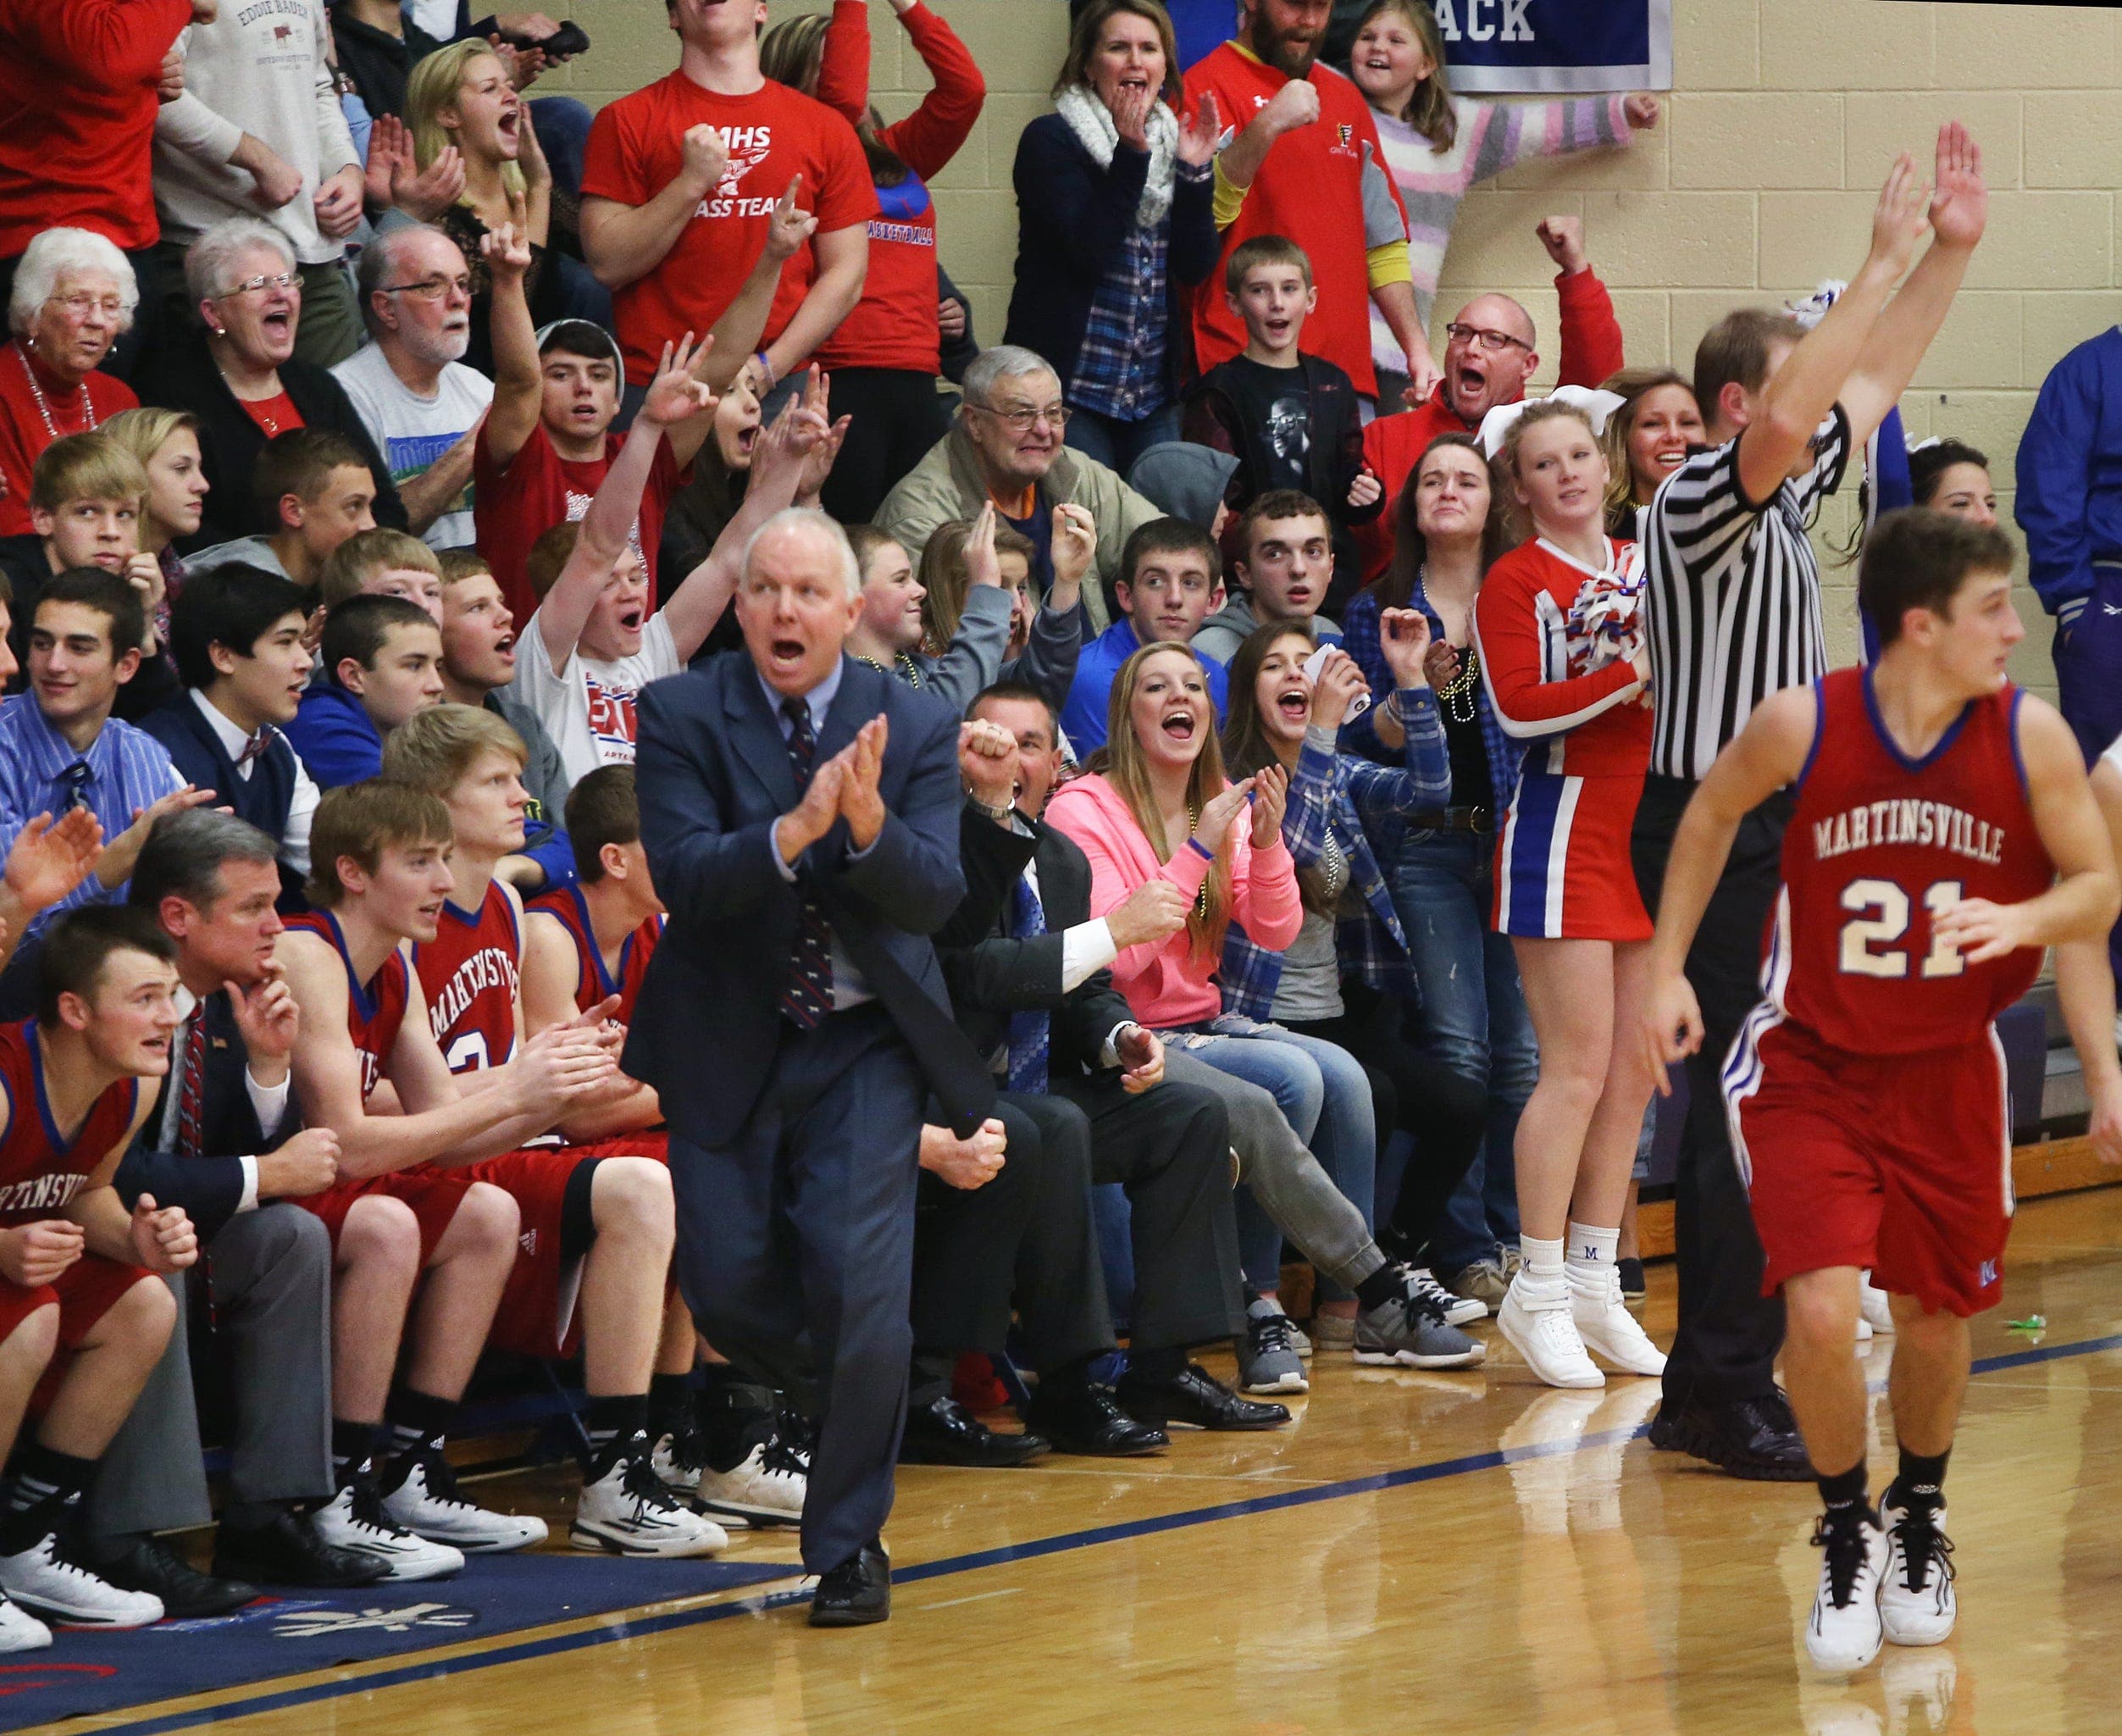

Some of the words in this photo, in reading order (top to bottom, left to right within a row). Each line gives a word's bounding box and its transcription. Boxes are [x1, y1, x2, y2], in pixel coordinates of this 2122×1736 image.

[238, 1, 274, 26] EDDIE
[1435, 0, 1535, 42] ACK
[694, 200, 734, 218] ASS
[737, 197, 784, 217] TEA
[867, 219, 933, 247] ASKETBALL
[1814, 798, 2006, 867] MARTINSVILLE
[1840, 878, 1967, 978] 21
[1584, 1245, 1598, 1260] M
